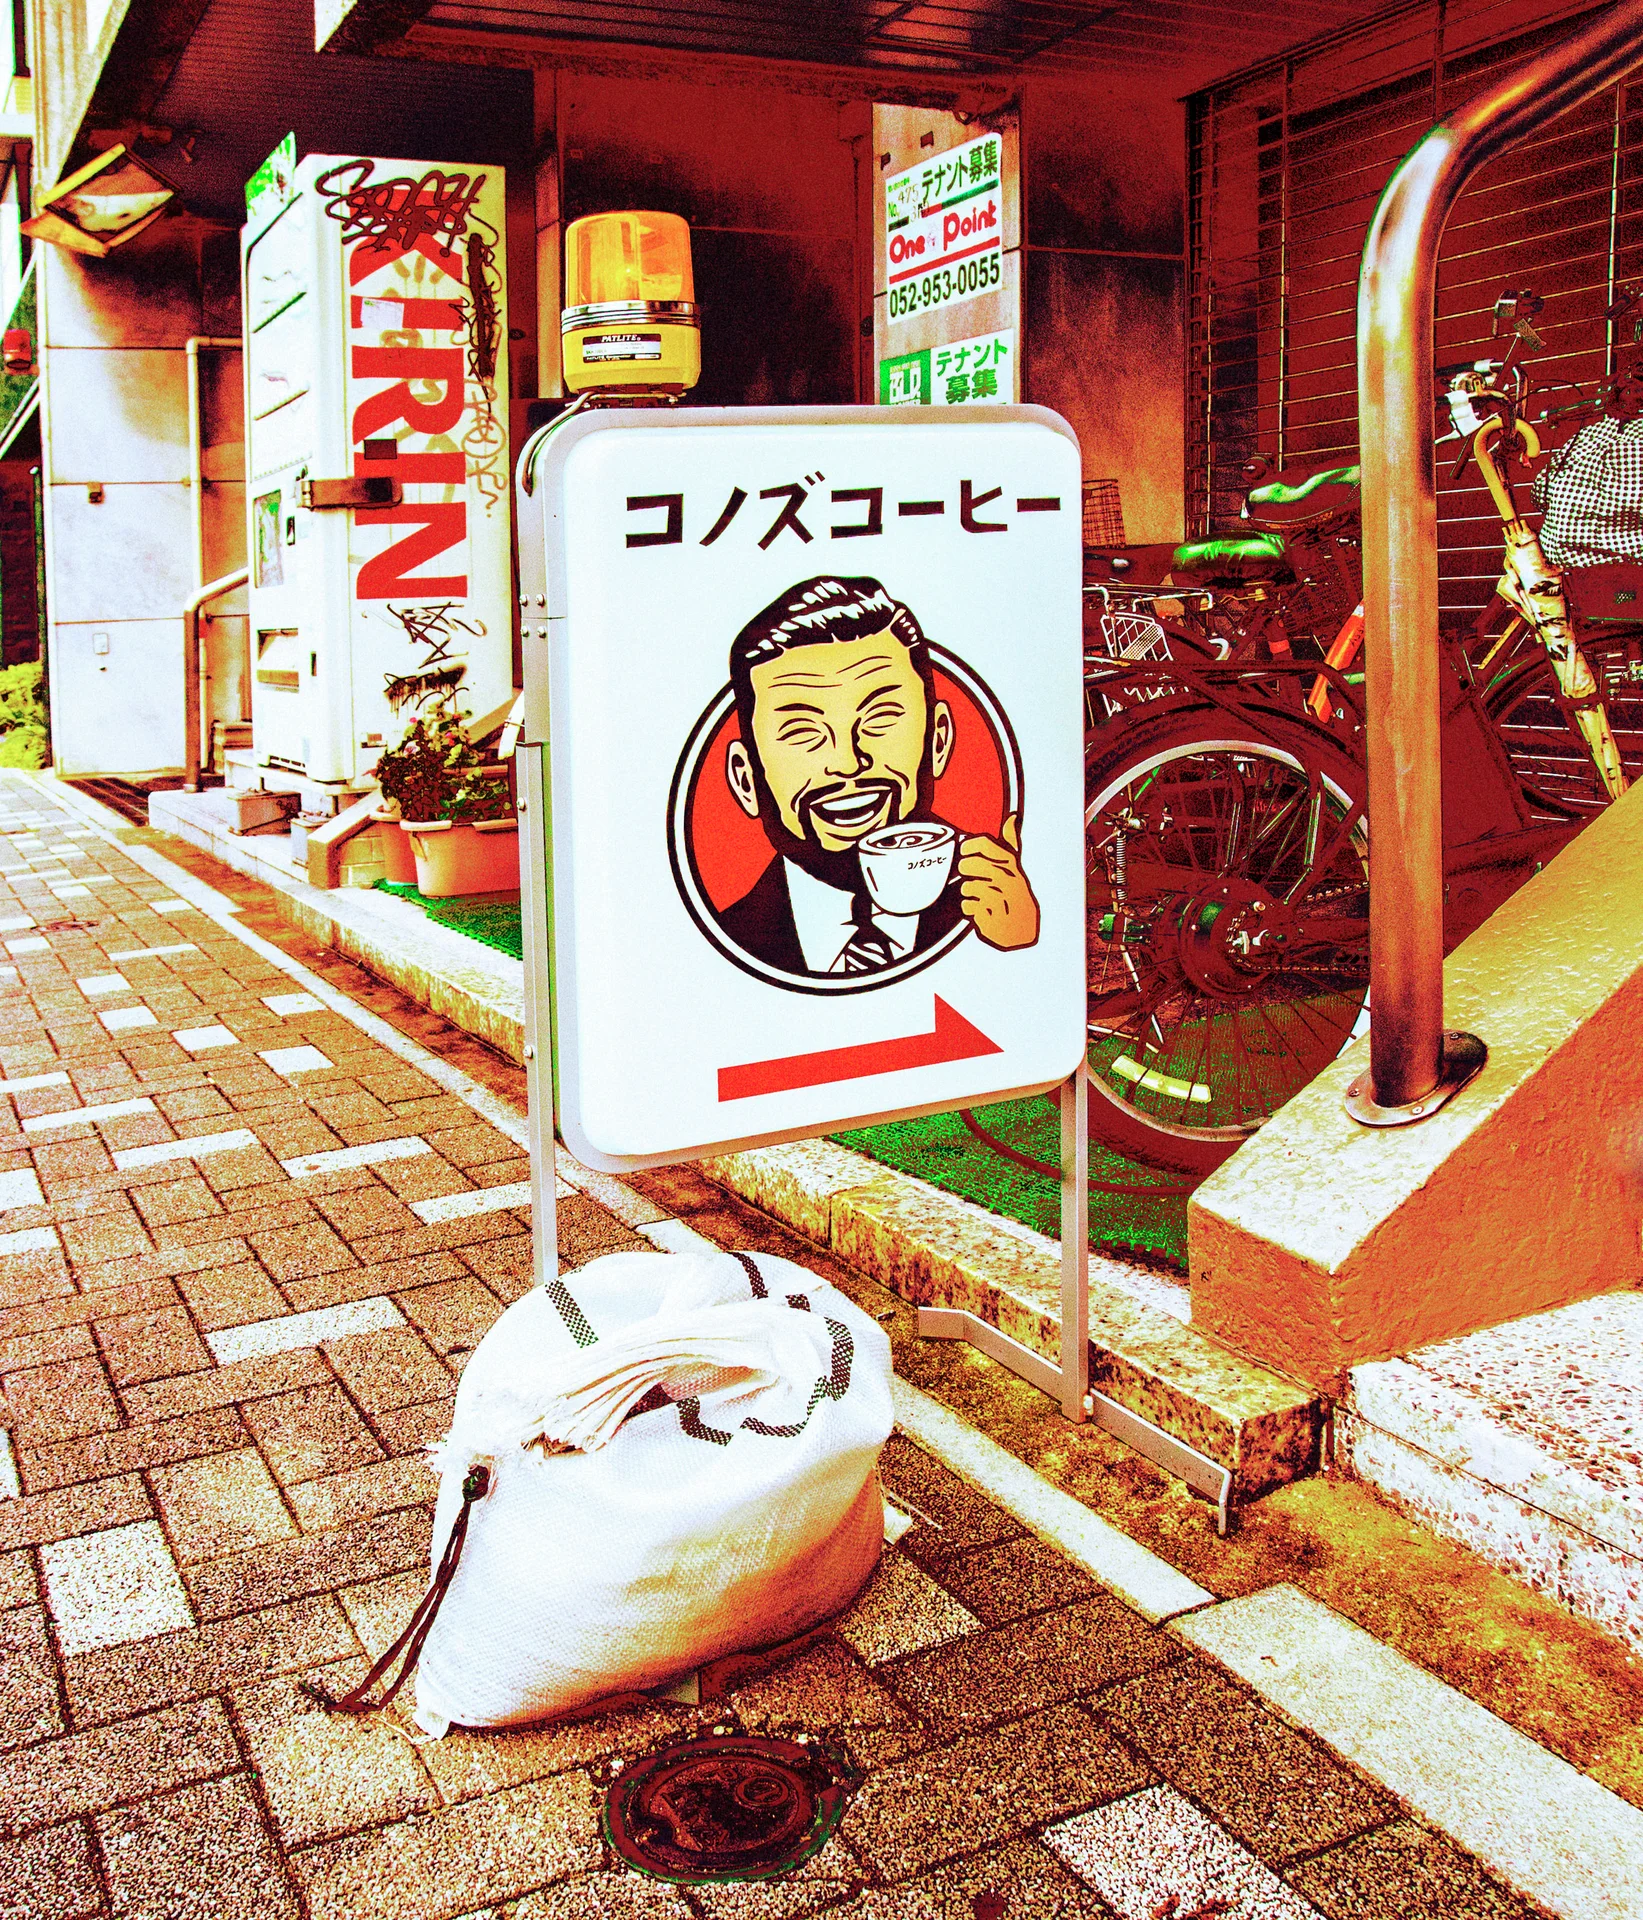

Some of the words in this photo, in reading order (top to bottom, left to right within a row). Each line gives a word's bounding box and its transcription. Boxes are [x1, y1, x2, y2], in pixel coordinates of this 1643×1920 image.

[922, 140, 997, 207] テナント募集
[889, 234, 926, 264] One
[889, 252, 1000, 318] 052-953-0055
[601, 334, 637, 343] PATLITE
[936, 338, 1008, 377] テナント
[350, 185, 468, 600] KIRIN
[945, 368, 998, 405] 募集
[626, 471, 1061, 551] コノズコーヒー
